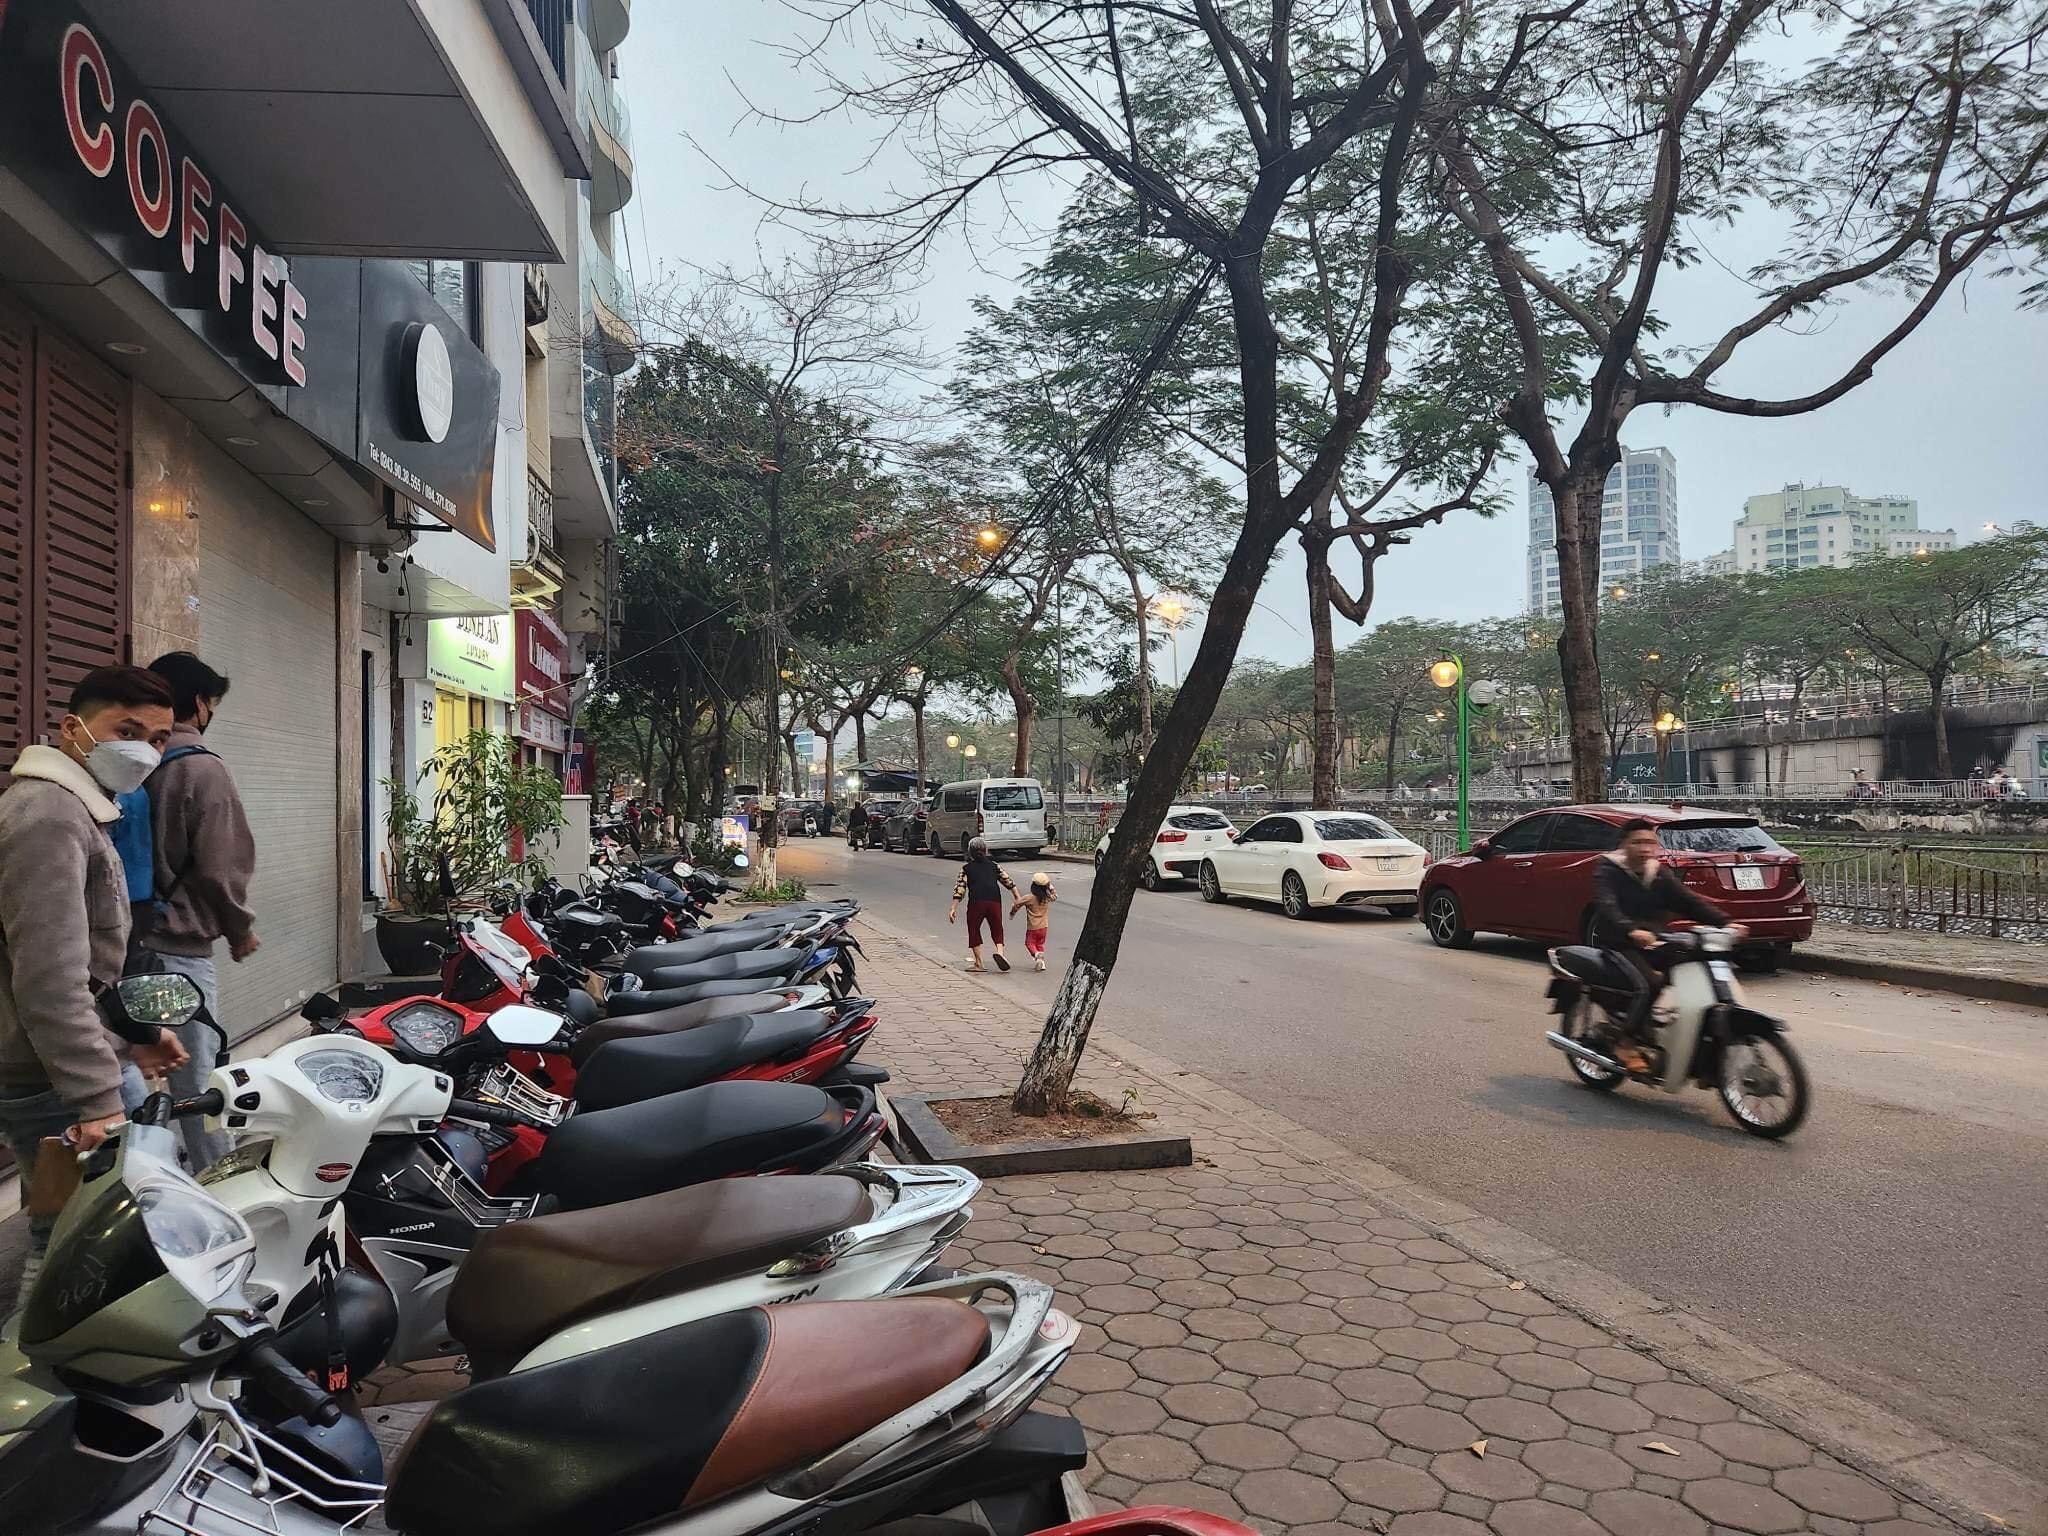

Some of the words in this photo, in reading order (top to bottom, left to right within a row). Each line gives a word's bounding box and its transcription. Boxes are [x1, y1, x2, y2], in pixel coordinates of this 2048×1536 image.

[61, 23, 306, 387] COFFEE
[369, 442, 379, 463] Tel:
[423, 700, 433, 721] 52
[389, 1221, 436, 1235] HONDA
